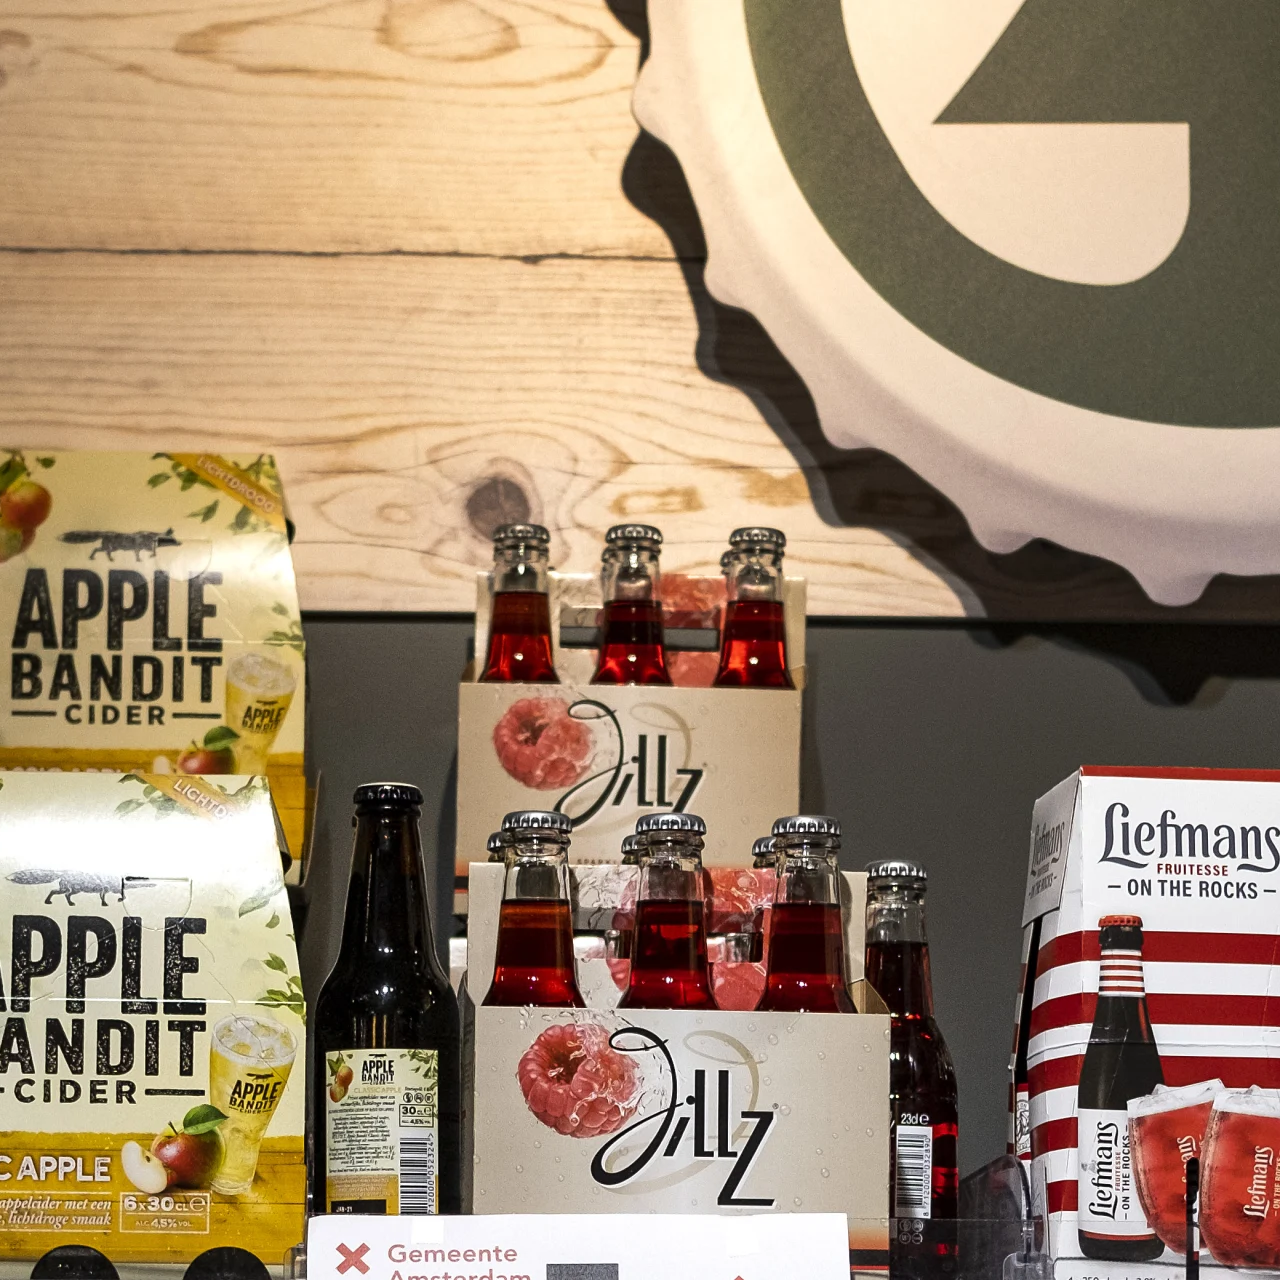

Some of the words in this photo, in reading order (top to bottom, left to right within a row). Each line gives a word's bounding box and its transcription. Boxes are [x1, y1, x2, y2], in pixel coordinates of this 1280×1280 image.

[11, 568, 223, 651] APPLE
[11, 653, 222, 702] BANDIT
[1098, 802, 1280, 872] Liefmans
[1157, 863, 1229, 877] FRUITESSE
[1127, 880, 1155, 897] ON
[1158, 881, 1194, 897] THE
[1198, 881, 1258, 899] ROCKS
[14, 1079, 137, 1104] CIDER
[17, 1157, 111, 1182] APPLE
[9, 1212, 69, 1229] lichtdroge
[72, 1212, 111, 1226] smaak
[388, 1245, 517, 1264] Gemeente
